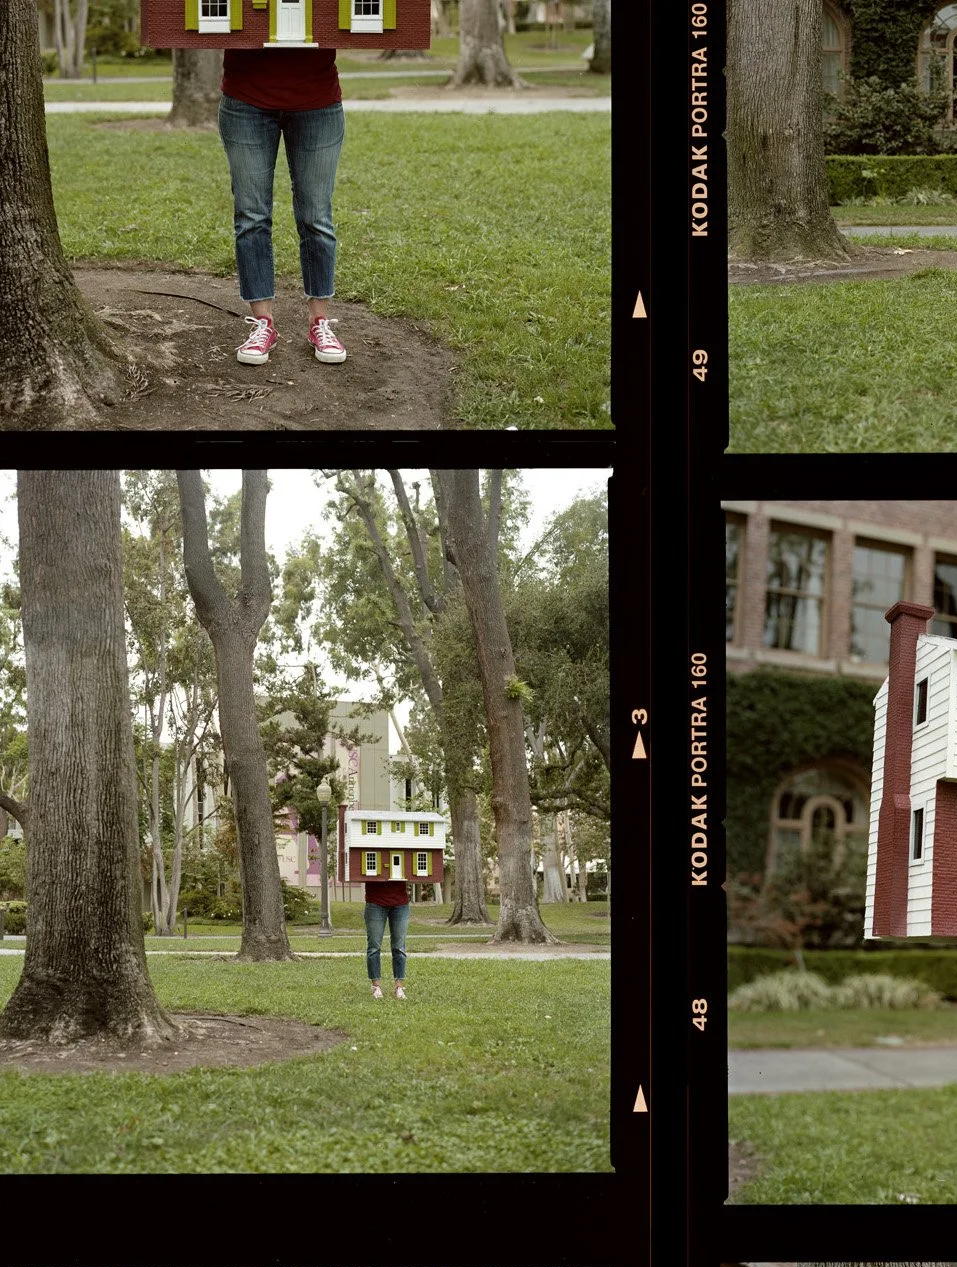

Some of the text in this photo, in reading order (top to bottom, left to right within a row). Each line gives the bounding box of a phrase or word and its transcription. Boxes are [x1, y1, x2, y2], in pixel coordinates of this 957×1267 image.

[691, 3, 709, 237] KODAK PORTRA 160
[692, 349, 709, 382] 49
[631, 708, 648, 725] 3
[690, 652, 708, 886] KODAK PORTRA 160
[691, 998, 708, 1032] 48
